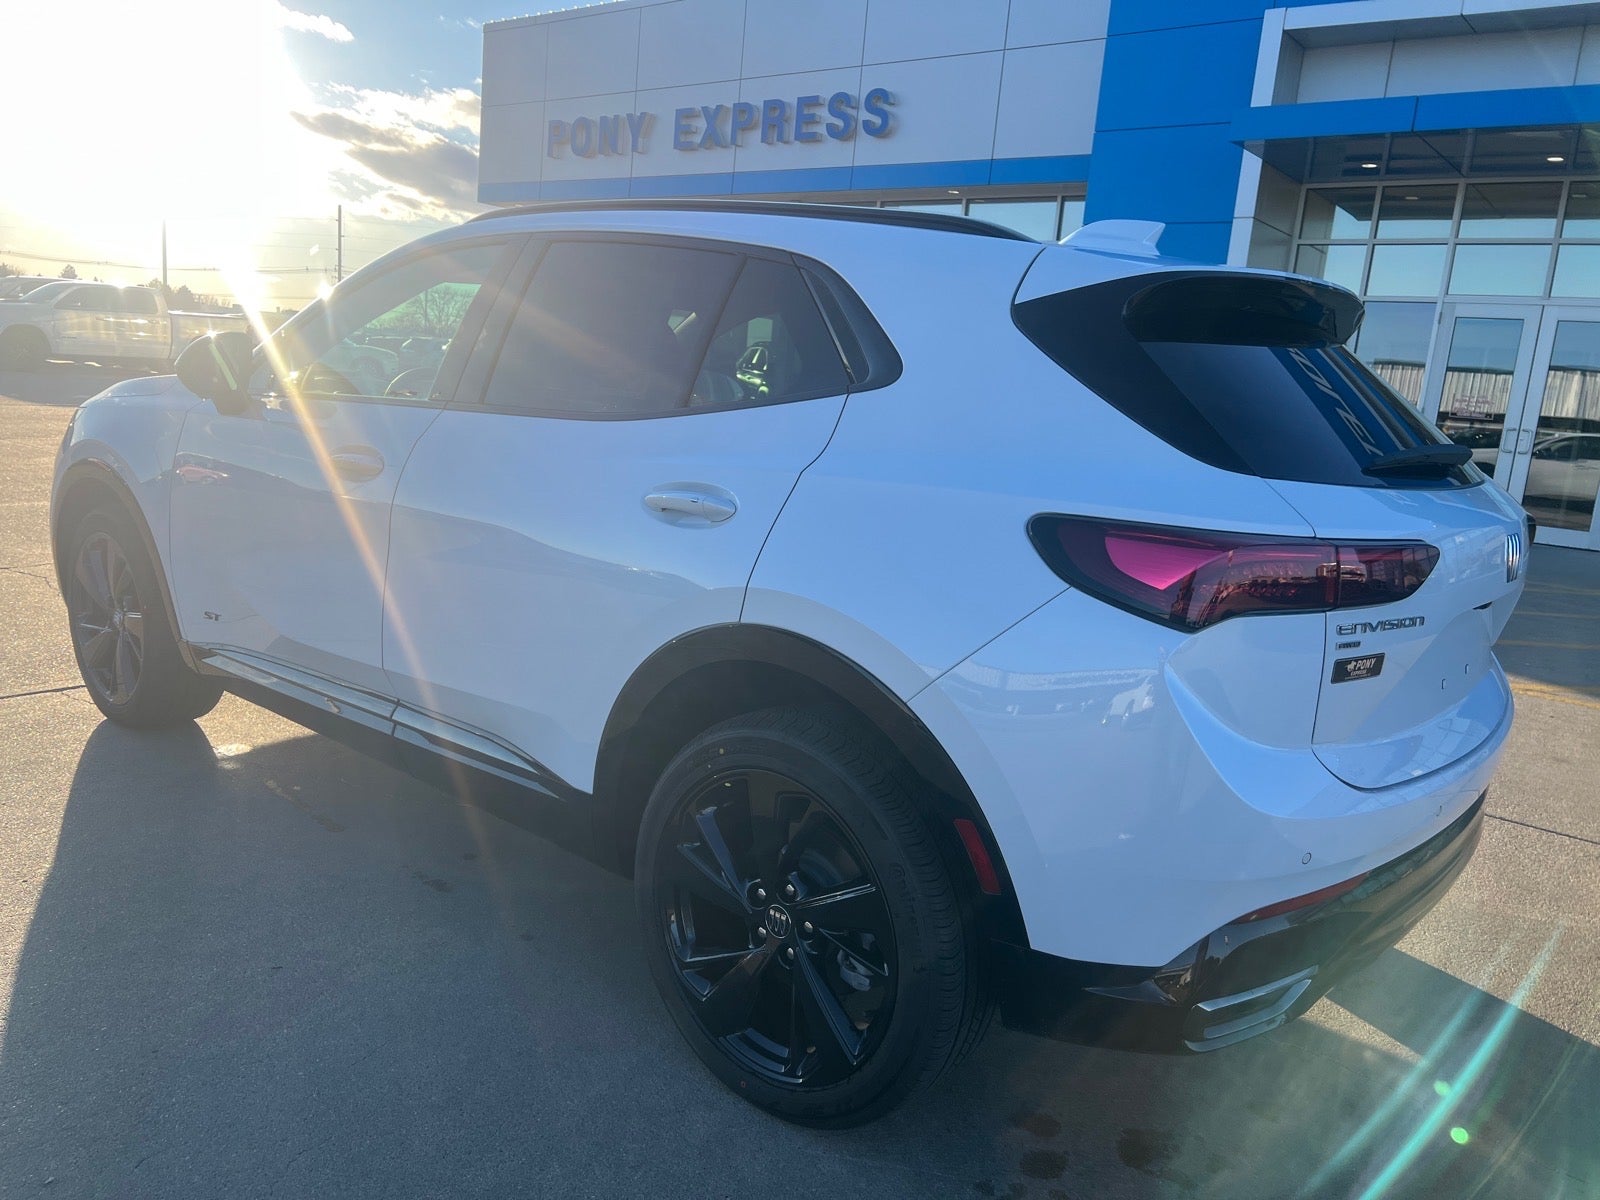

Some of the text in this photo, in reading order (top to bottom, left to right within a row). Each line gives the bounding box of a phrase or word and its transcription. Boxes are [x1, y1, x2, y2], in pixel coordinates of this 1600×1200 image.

[549, 87, 896, 159] PONY EXPRESS
[203, 611, 221, 621] ST
[1336, 616, 1425, 636] ENVISION
[1355, 658, 1376, 671] PONY
